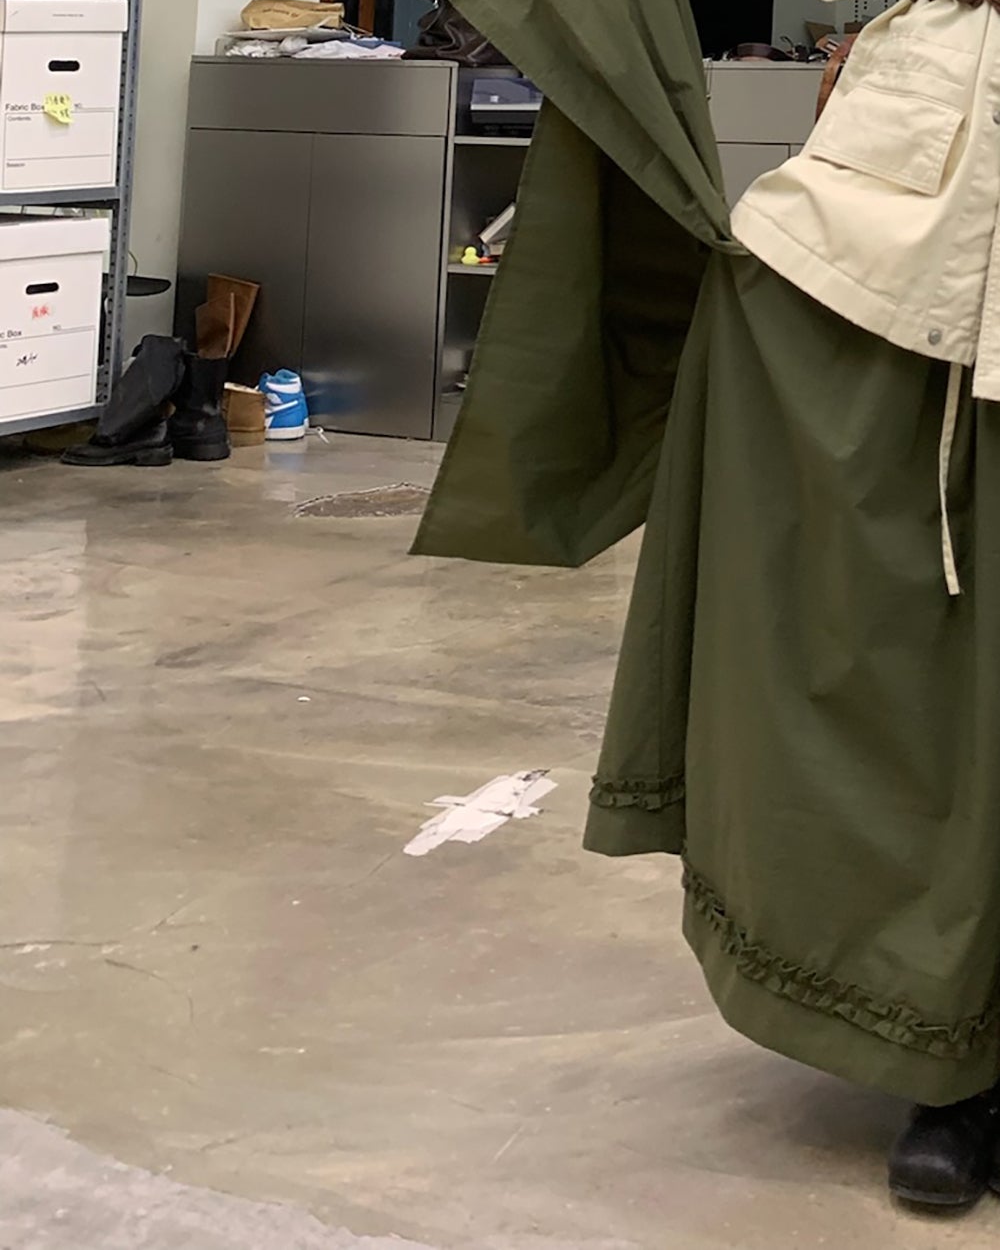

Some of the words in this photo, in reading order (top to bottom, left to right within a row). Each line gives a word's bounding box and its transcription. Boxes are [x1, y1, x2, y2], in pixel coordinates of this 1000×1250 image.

[5, 103, 29, 111] Fabric
[30, 103, 45, 111] Box
[7, 330, 21, 338] Box
